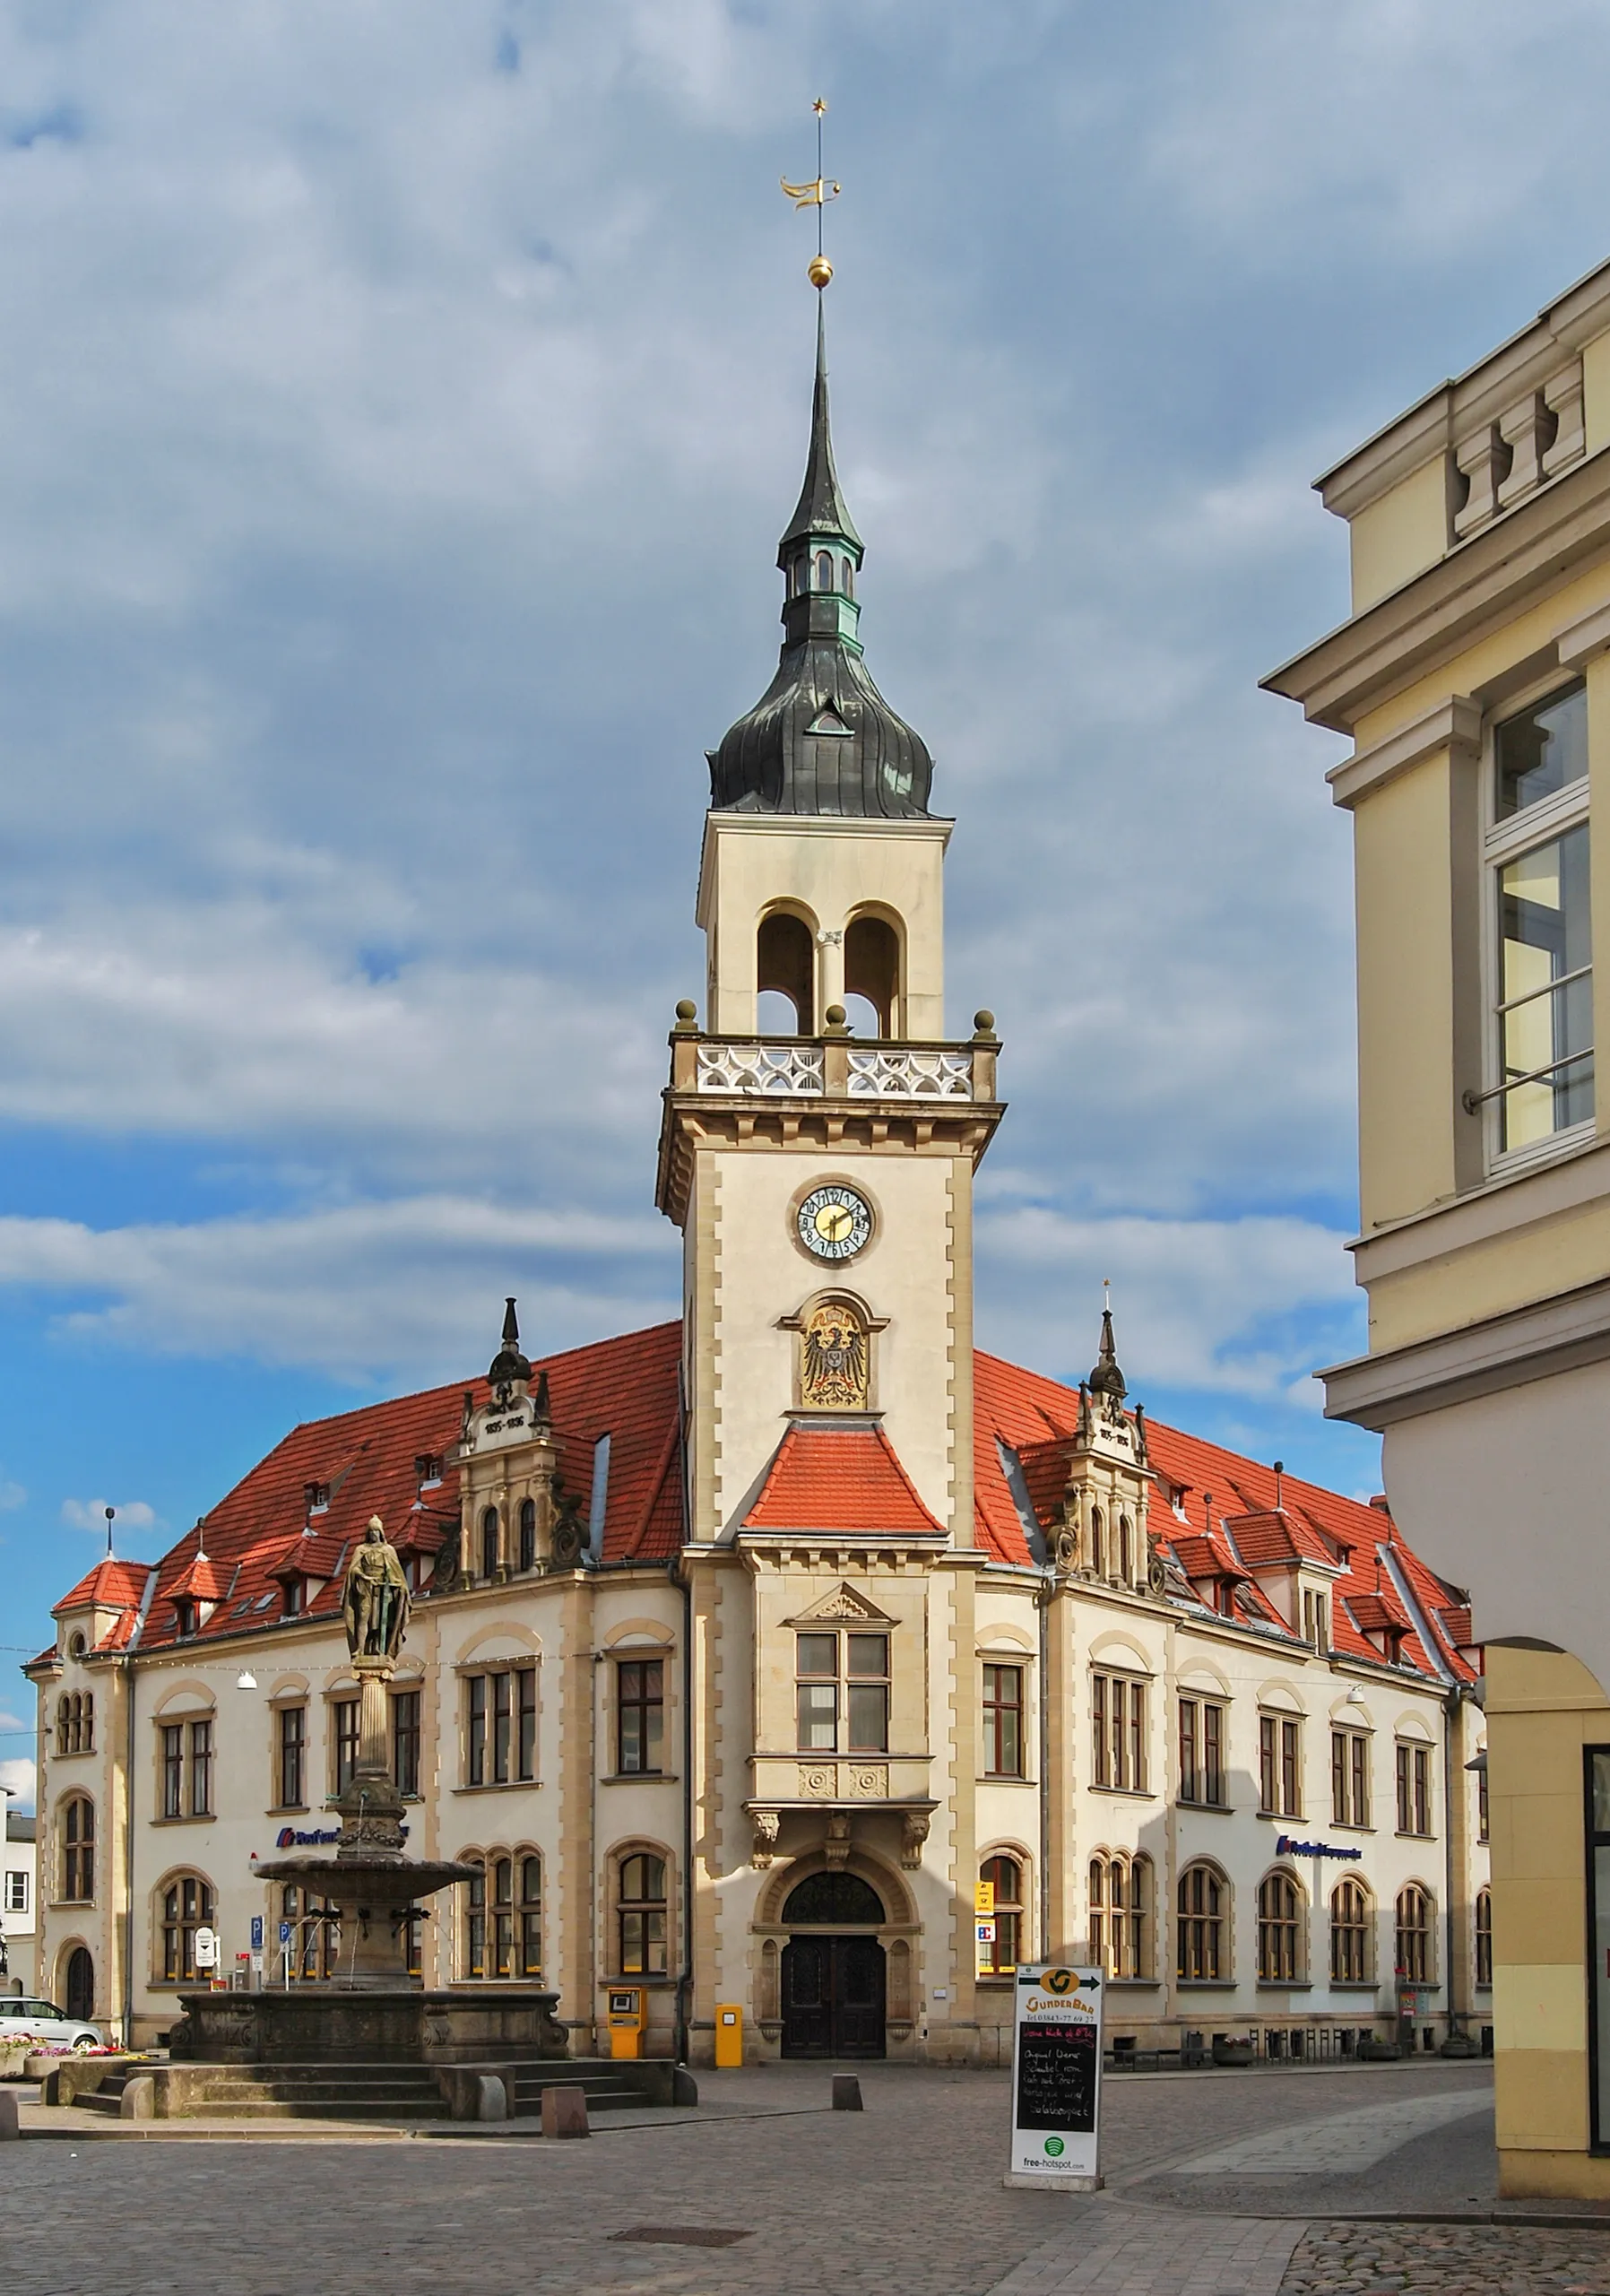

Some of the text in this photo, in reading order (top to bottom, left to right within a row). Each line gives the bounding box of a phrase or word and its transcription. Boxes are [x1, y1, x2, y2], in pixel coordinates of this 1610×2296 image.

[815, 1194, 825, 1206] 11
[829, 1191, 839, 1203] 12
[844, 1194, 850, 1205] 1
[803, 1202, 815, 1214] 10
[802, 1217, 809, 1230] 9
[806, 1230, 813, 1243] 8
[853, 1232, 860, 1243] 4
[819, 1241, 825, 1253] 7
[832, 1243, 838, 1256] 6
[844, 1241, 850, 1252] 5
[253, 1920, 261, 1939] P
[281, 1926, 288, 1940] P
[1085, 2015, 1095, 2023] 27
[1024, 2157, 1085, 2170] free-hotspot.com
